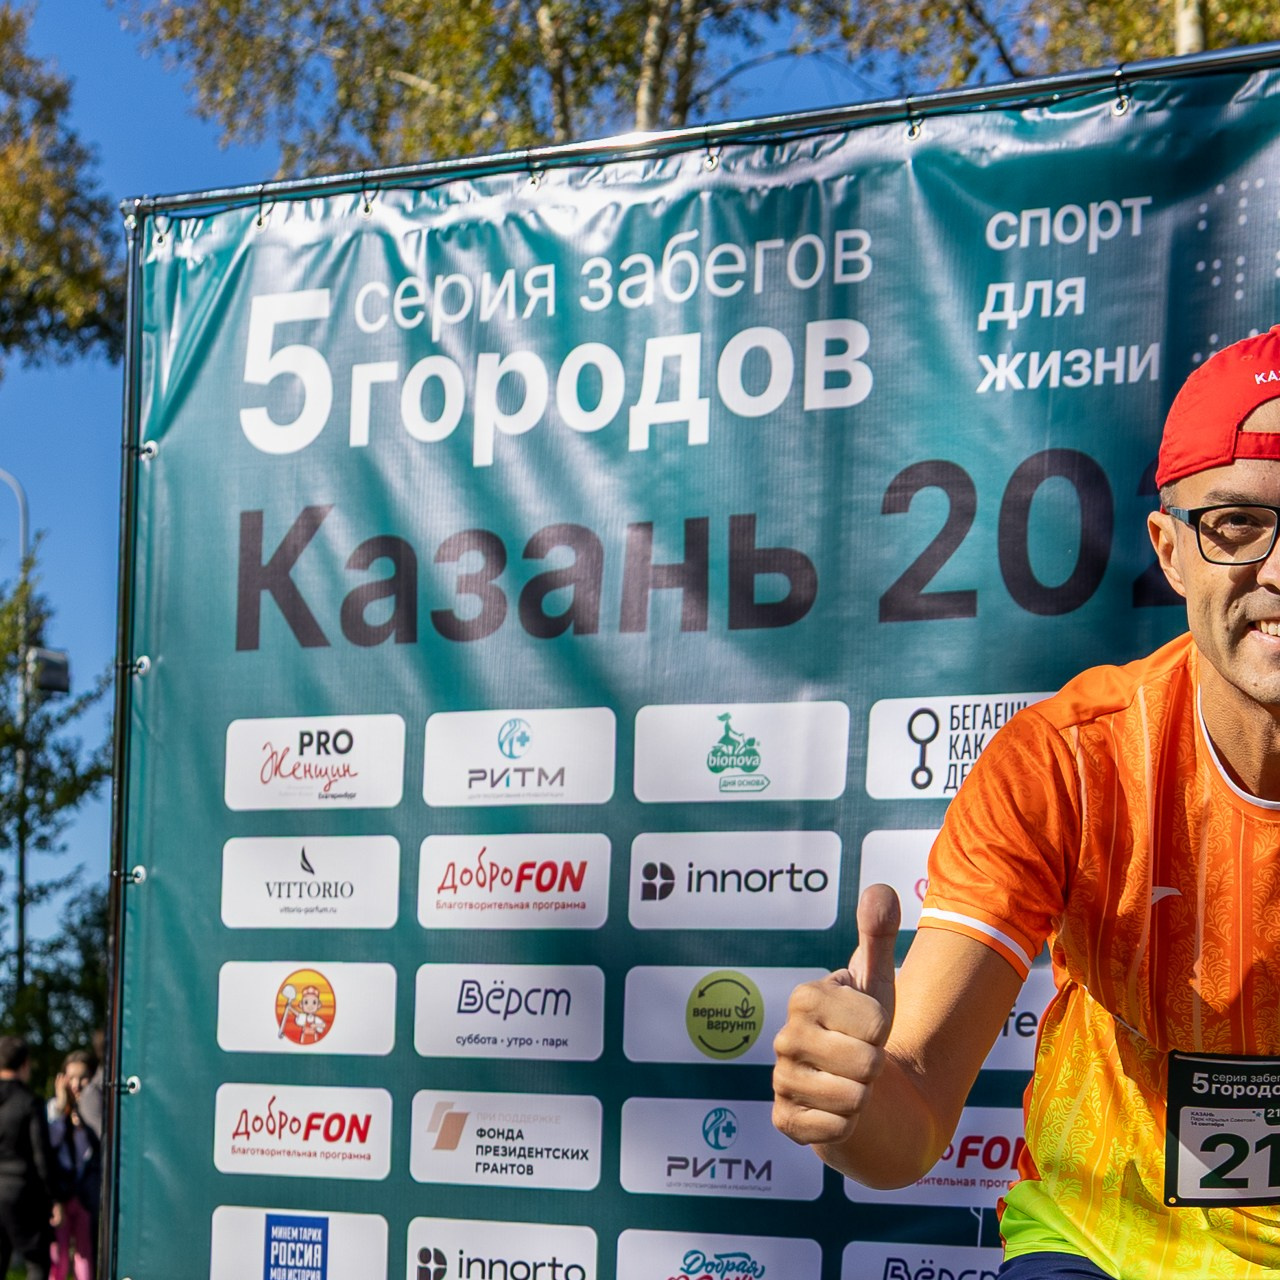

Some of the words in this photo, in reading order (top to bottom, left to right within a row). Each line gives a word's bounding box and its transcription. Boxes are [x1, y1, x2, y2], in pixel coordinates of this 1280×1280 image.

[985, 196, 1152, 254] спорт
[355, 264, 555, 342] серия
[579, 228, 873, 313] забегов
[978, 276, 1086, 331] для
[240, 288, 333, 455] 5
[976, 342, 1160, 393] жизни
[349, 318, 873, 466] городов
[235, 504, 818, 651] Казань
[299, 729, 353, 756] PRO
[949, 733, 985, 760] КАК
[261, 741, 358, 792] Женщин
[708, 751, 759, 767] bionova
[468, 767, 565, 788] РИТМ
[437, 846, 588, 893] ДоброFON
[687, 862, 828, 892] innorto
[265, 881, 354, 899] VITTORIO
[436, 900, 530, 912] Благотворительная
[532, 900, 586, 912] программа
[693, 1007, 731, 1019] верни
[707, 1017, 756, 1032] вгрунт
[456, 1034, 497, 1046] суббота
[507, 1037, 532, 1048] утро
[542, 1038, 568, 1048] парк
[1192, 1072, 1209, 1094] 5
[1212, 1074, 1247, 1084] серия
[232, 1095, 371, 1144] ДоброFON
[476, 1128, 524, 1141] ФОНДА
[231, 1145, 317, 1160] Благотворительная
[319, 1149, 371, 1161] программа
[476, 1145, 589, 1160] ПРЕЗИДЕНТСКИХ
[475, 1162, 534, 1175] ГРАНТОВ
[667, 1156, 772, 1181] РИТМ
[270, 1241, 322, 1268] РОССИЯ
[680, 1249, 765, 1280] Добрая
